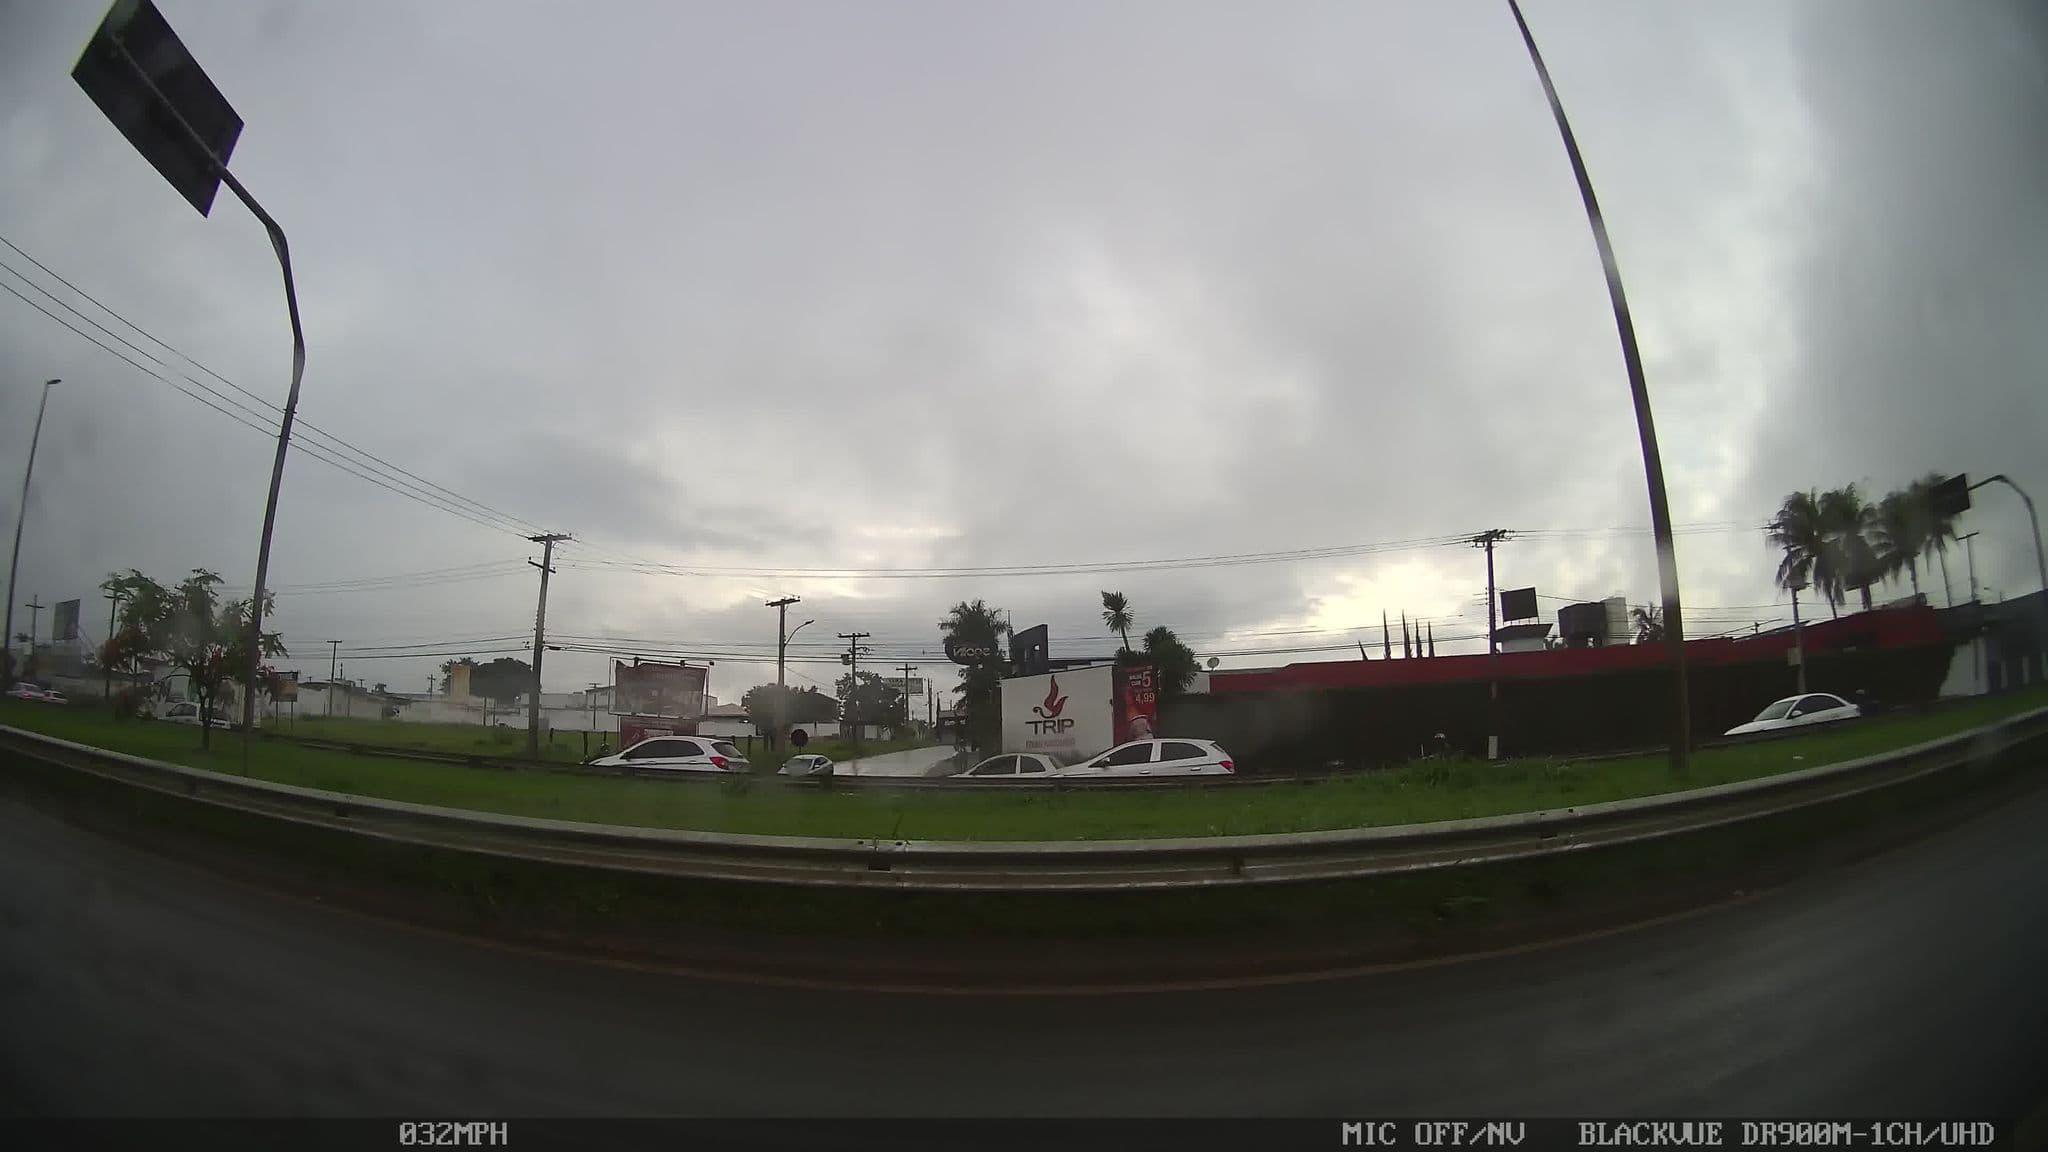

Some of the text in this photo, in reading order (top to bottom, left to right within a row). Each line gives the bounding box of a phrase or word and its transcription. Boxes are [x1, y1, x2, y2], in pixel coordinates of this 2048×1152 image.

[1142, 671, 1151, 688] 5
[1135, 692, 1155, 704] 4,99
[1025, 718, 1075, 735] TRIP
